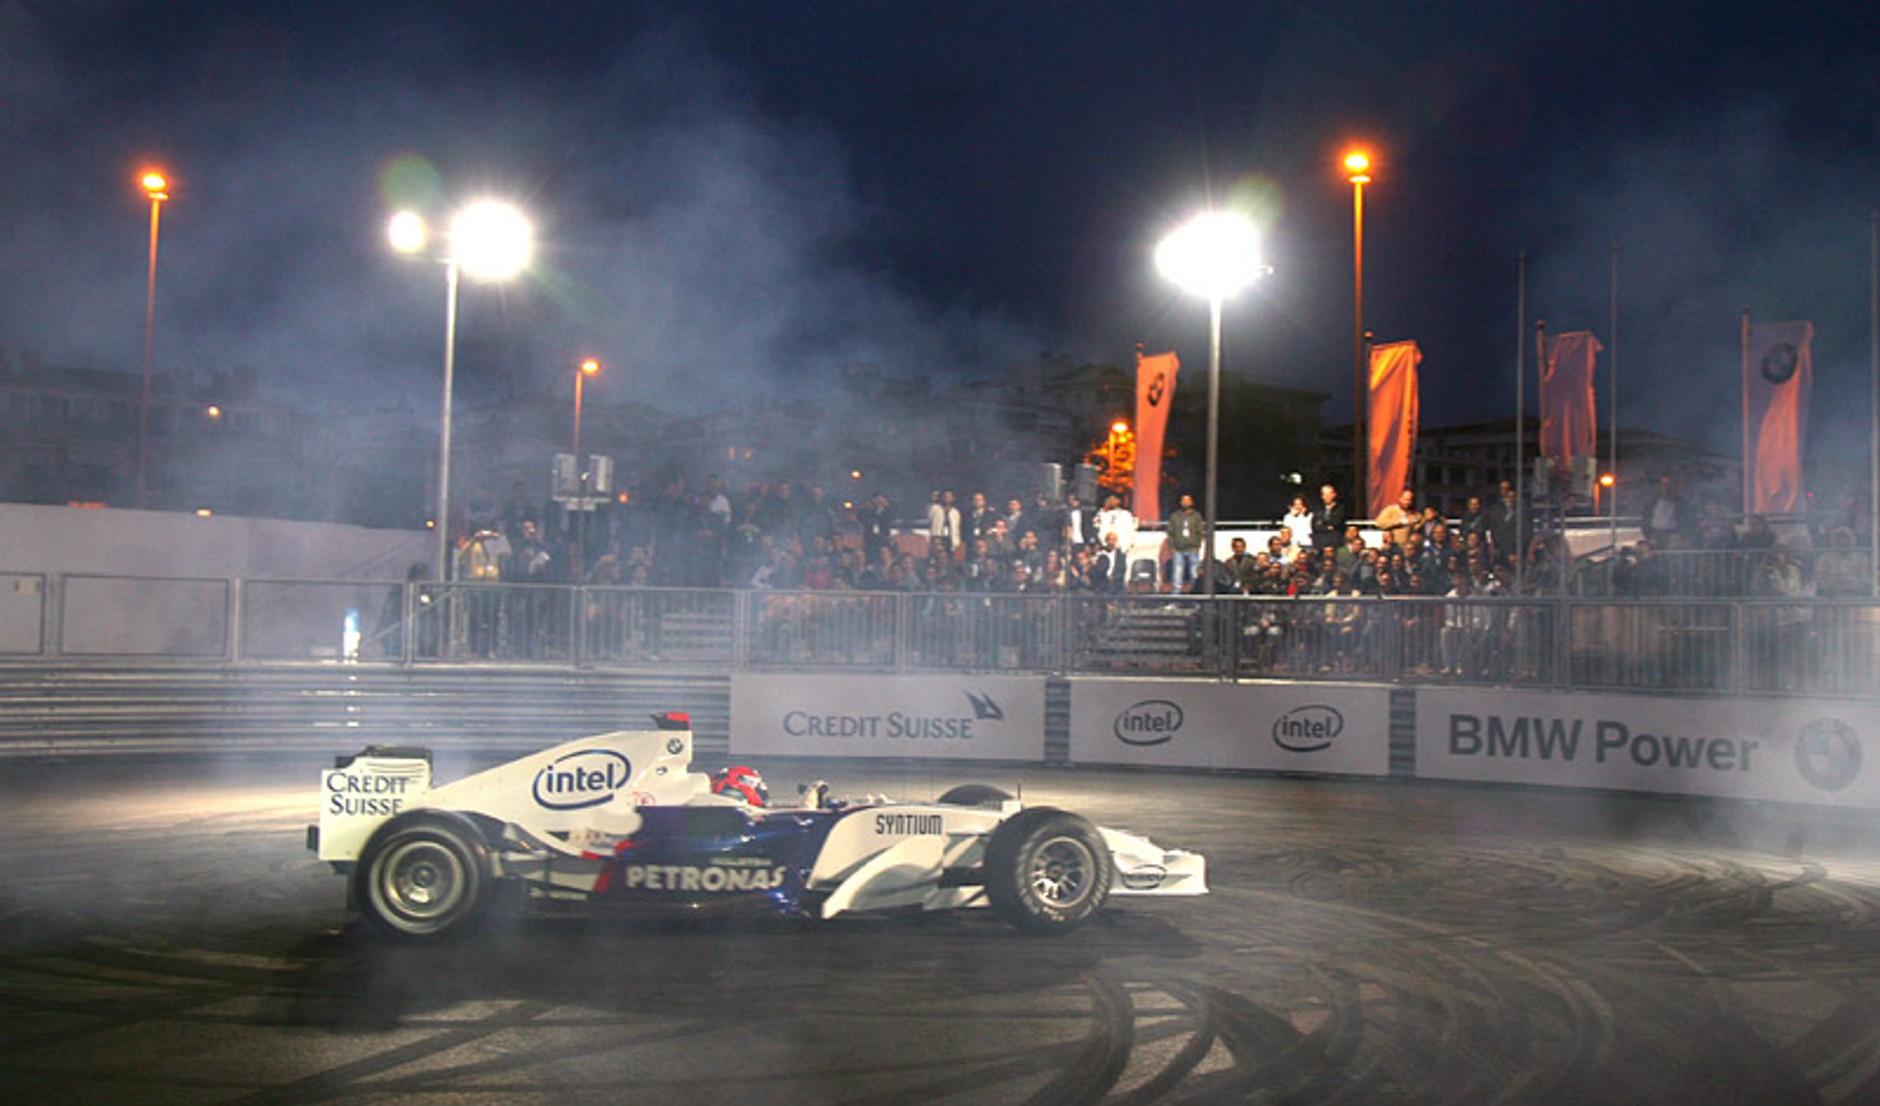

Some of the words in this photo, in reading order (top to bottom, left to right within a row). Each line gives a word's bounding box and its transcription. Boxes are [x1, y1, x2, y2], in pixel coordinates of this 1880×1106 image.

[783, 710, 881, 737] CREDIT
[886, 711, 974, 739] SUISSE
[1123, 711, 1173, 732] intel
[1282, 715, 1332, 739] intel
[1449, 714, 1583, 761] BMW
[1595, 720, 1760, 772] Power
[326, 772, 411, 795] CREDIT
[546, 763, 614, 793] intel
[875, 813, 943, 836] SYNTIUM
[626, 864, 788, 892] PETRONAS
